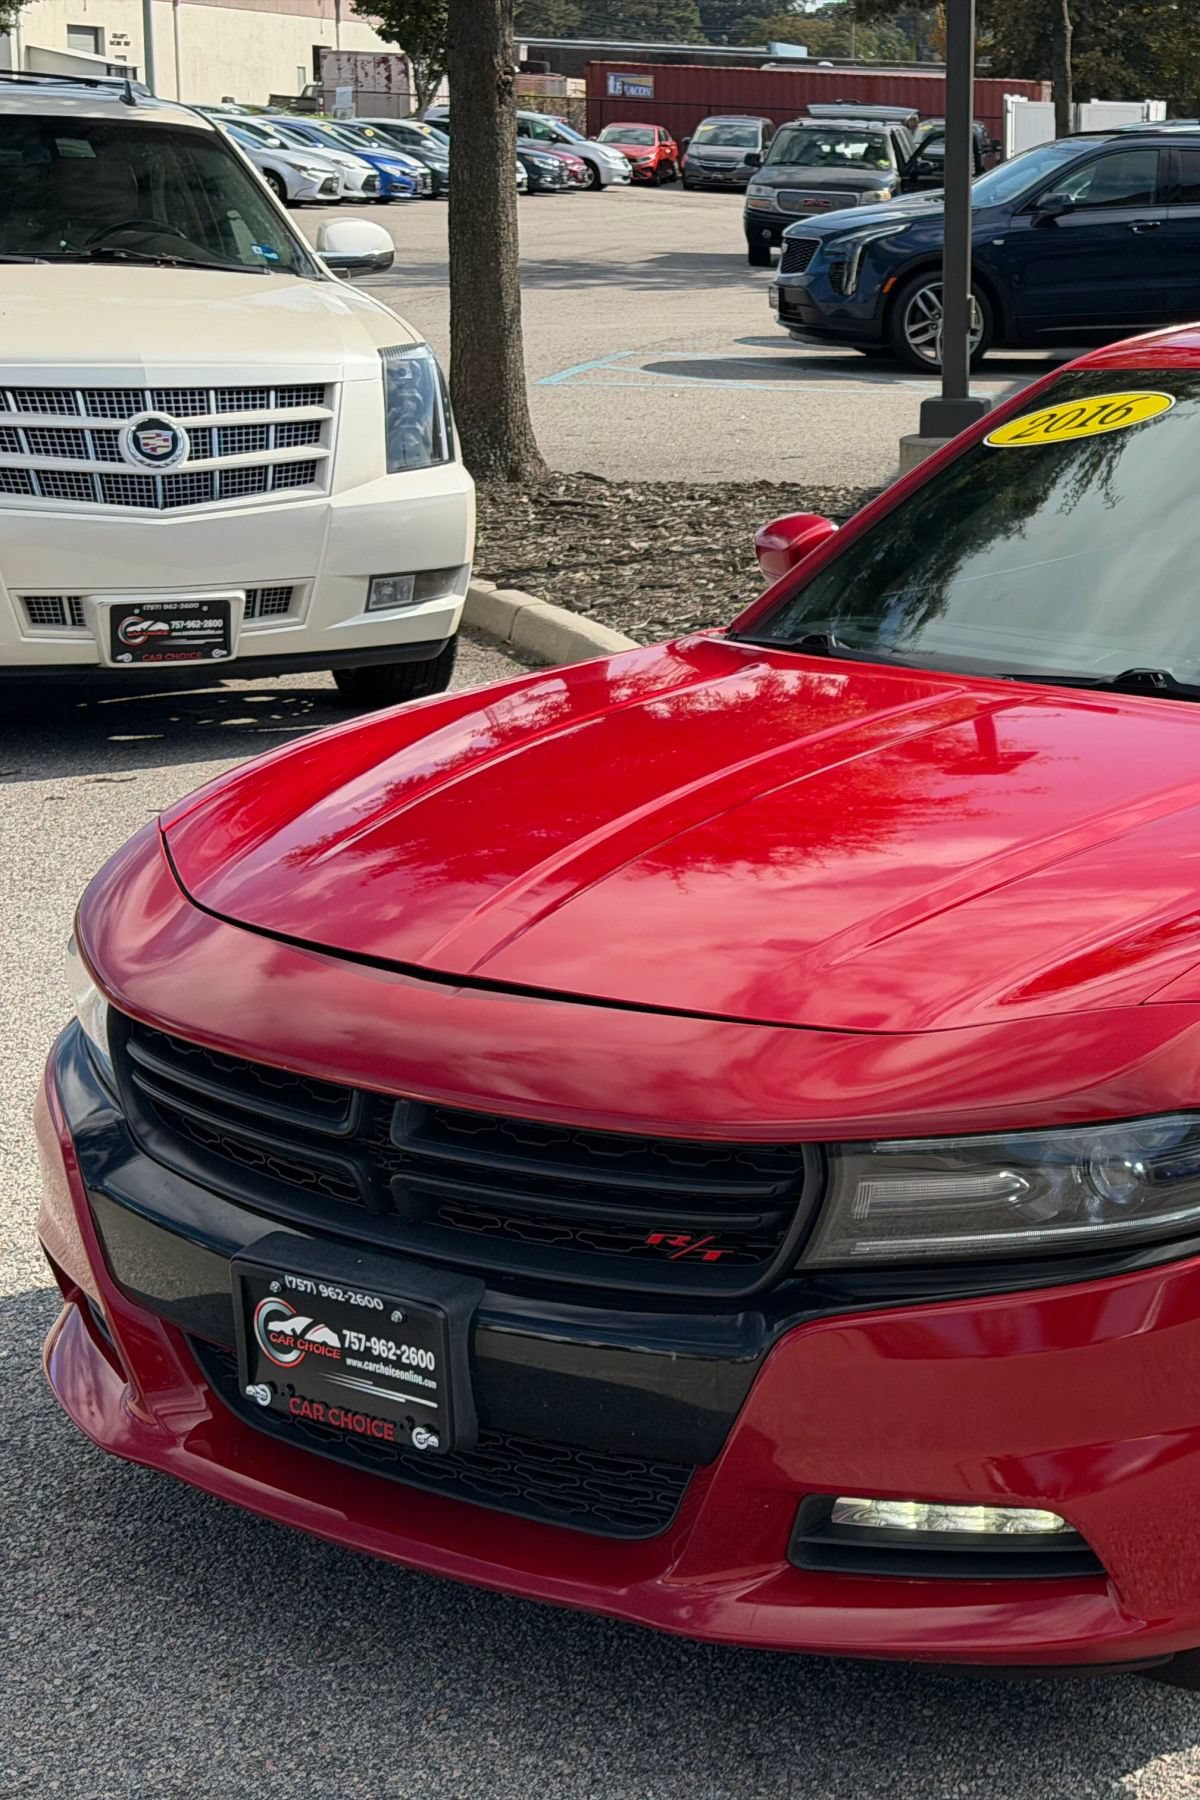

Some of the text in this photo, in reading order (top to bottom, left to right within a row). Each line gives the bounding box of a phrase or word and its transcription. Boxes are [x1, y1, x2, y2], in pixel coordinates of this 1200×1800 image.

[1007, 396, 1151, 442] 2016
[170, 619, 224, 629] 757-962-2600
[142, 651, 204, 662] CAR CHOICE
[645, 1232, 735, 1262] R/T
[284, 1274, 384, 1311] (757) 962-2600
[269, 1331, 342, 1360] CAR CHOICE
[342, 1329, 436, 1372] 757-962-2600
[345, 1356, 438, 1390] www.carchoiceonline.com
[288, 1396, 396, 1441] CAR CHOICE
